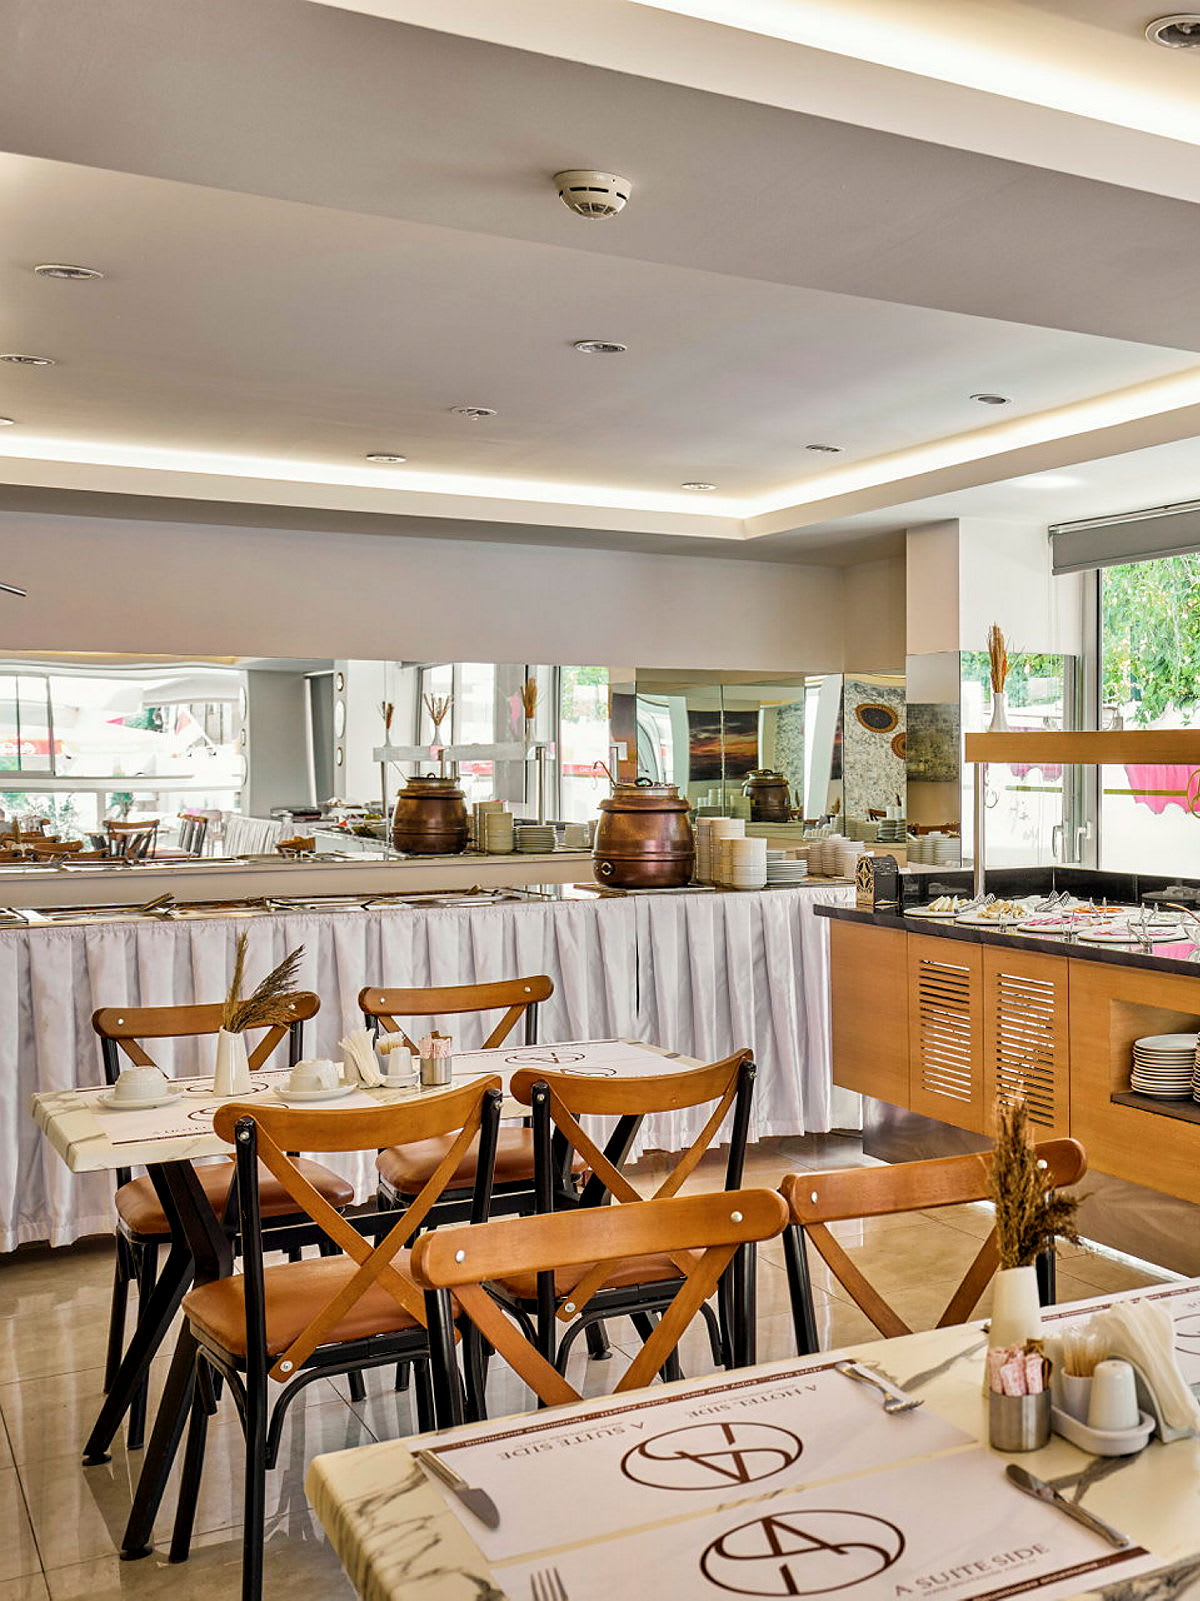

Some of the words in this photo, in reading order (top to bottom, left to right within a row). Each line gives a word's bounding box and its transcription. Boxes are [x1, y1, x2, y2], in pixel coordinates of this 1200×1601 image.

[733, 1388, 802, 1407] HOTEL
[685, 1403, 731, 1418] SIDE
[630, 1421, 644, 1430] A
[557, 1426, 626, 1446] SUITE
[497, 1442, 553, 1460] SIDE
[894, 1584, 912, 1598] A
[915, 1559, 992, 1589] SUITE
[991, 1543, 1050, 1567] SIDE
